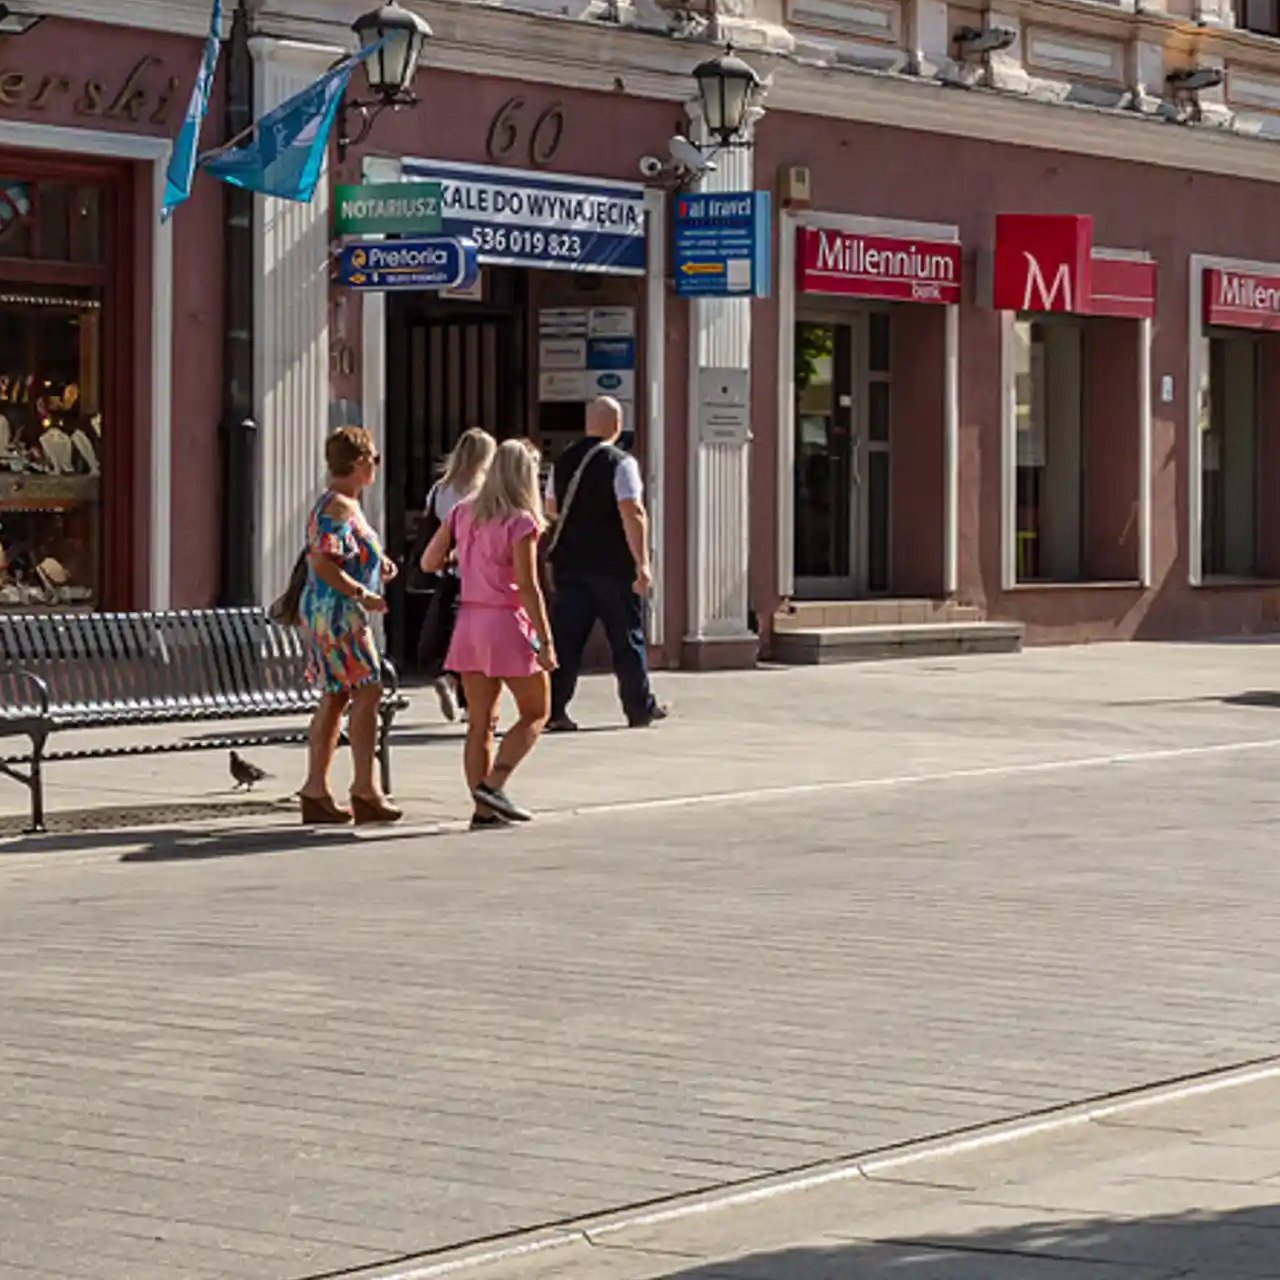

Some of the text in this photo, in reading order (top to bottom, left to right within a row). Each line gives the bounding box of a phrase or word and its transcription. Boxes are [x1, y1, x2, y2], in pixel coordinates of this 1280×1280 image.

[485, 94, 566, 165] 60
[341, 197, 438, 221] NOTARIUSZ
[493, 189, 524, 215] DO
[528, 192, 639, 229] WYNAJĘCIA
[369, 247, 448, 267] Pretoria
[472, 226, 581, 257] 536 019 823
[817, 230, 954, 280] Millennium
[1022, 251, 1072, 311] M
